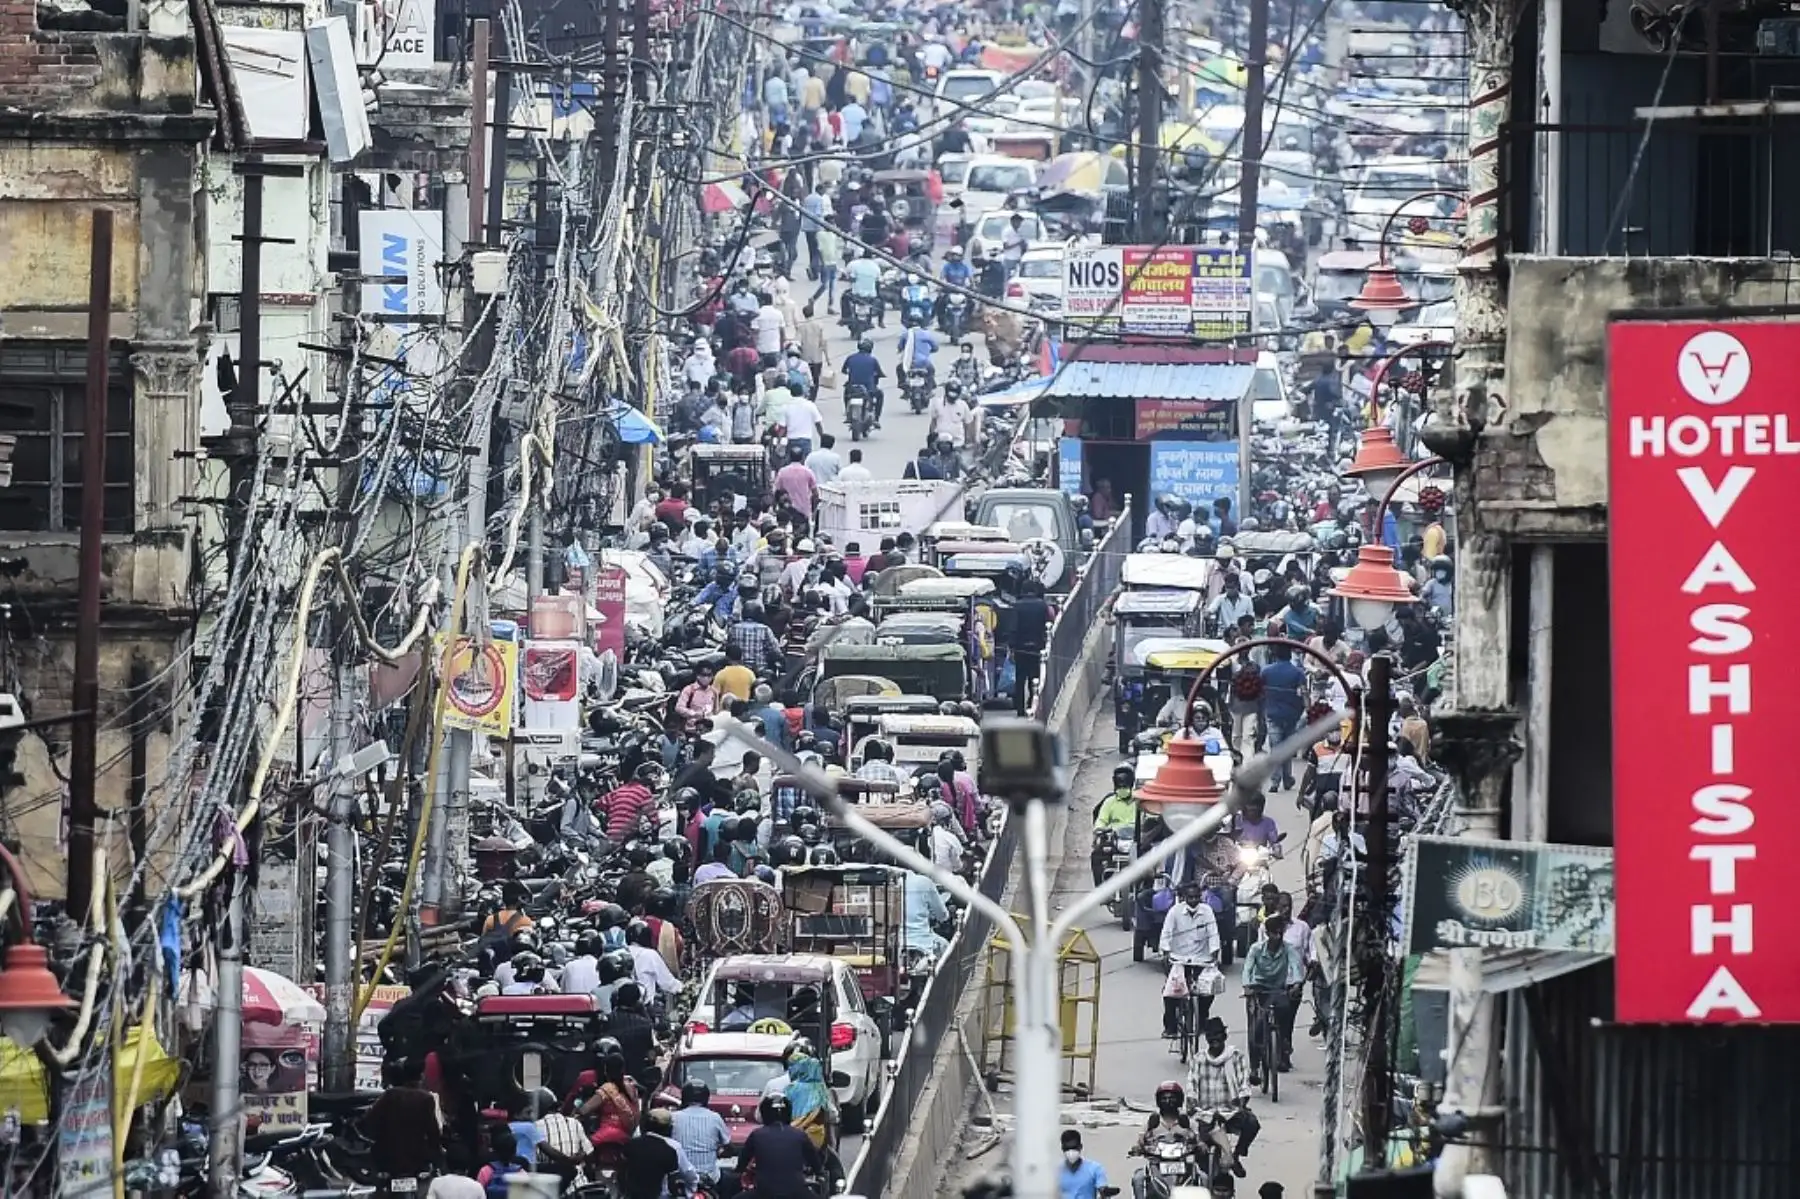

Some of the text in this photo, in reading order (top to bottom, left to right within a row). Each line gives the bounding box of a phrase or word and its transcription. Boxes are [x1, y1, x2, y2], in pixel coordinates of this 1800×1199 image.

[1069, 261, 1119, 288] NIOS
[1629, 413, 1800, 457] HOTEL
[1676, 465, 1762, 1018] VASHISTHA
[1436, 918, 1465, 943] श्री
